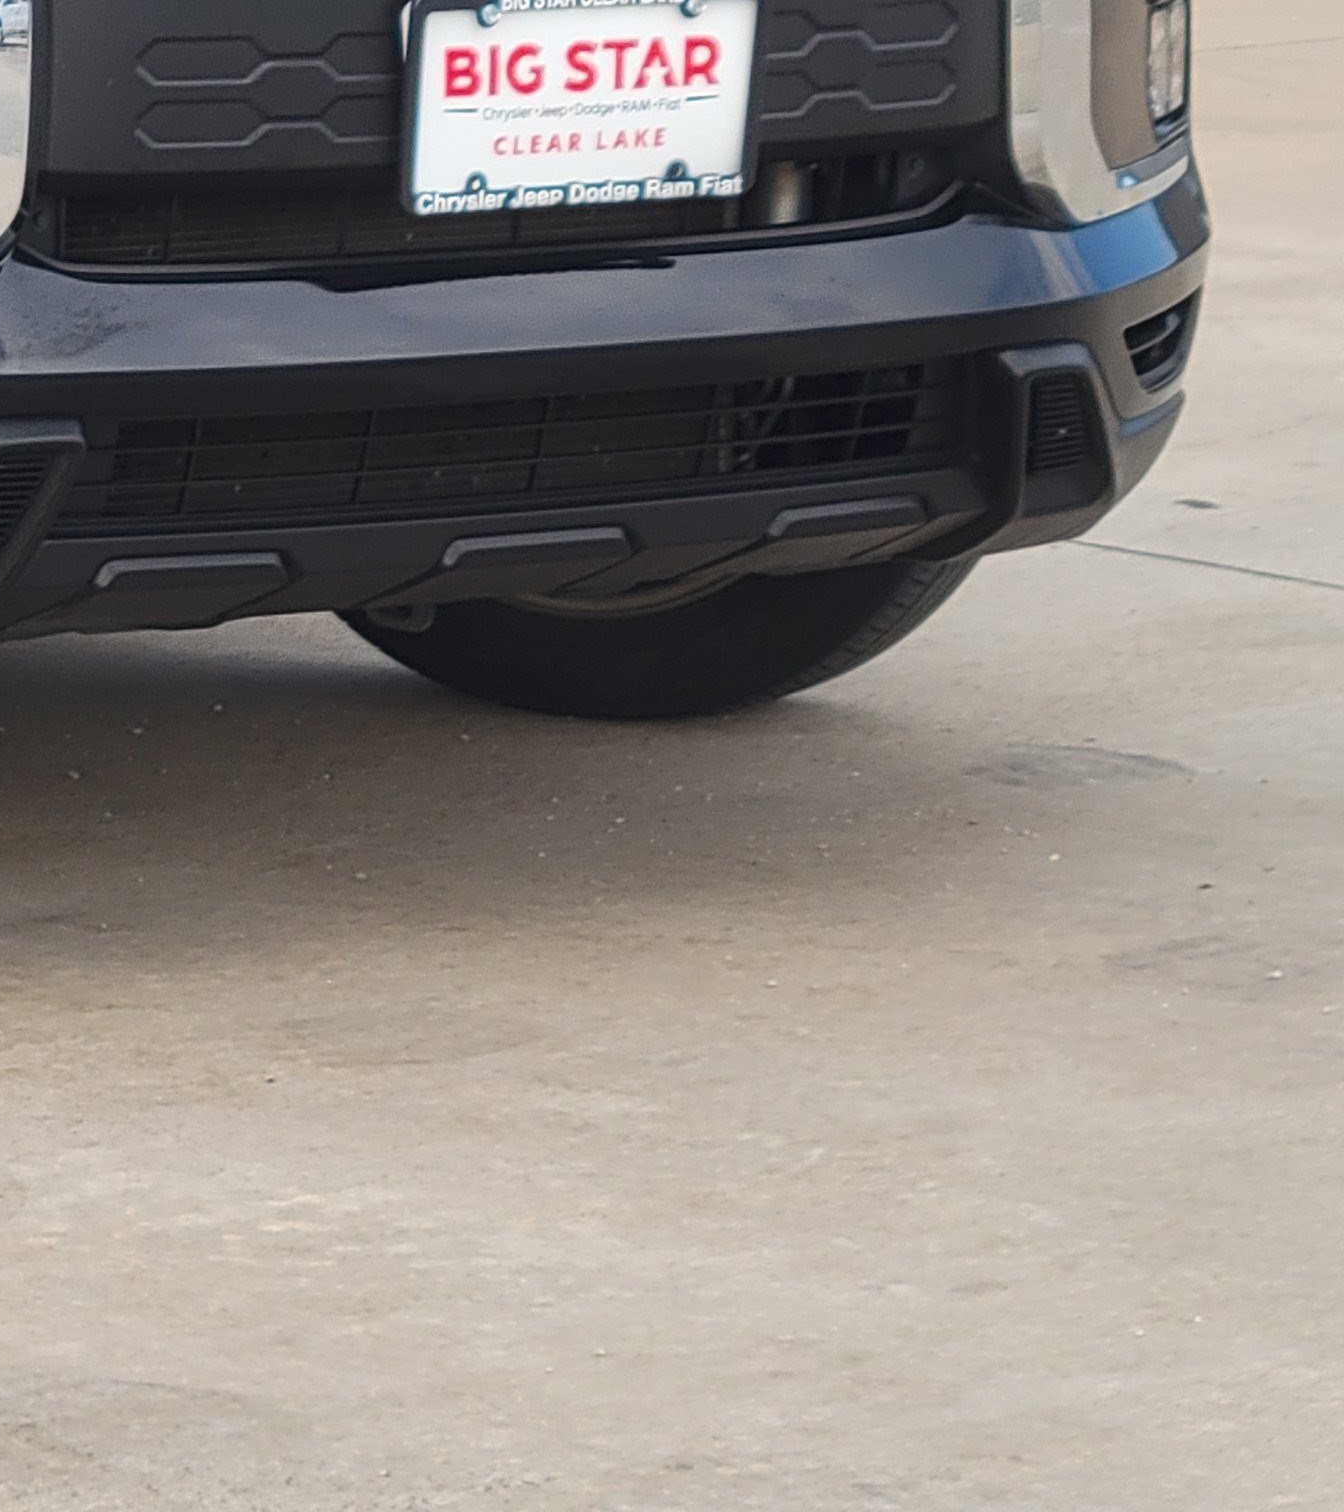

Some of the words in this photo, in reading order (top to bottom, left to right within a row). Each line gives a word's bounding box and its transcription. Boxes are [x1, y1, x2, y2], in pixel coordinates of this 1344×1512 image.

[443, 44, 546, 98] BIG
[563, 35, 719, 93] STAR
[493, 135, 582, 155] CLEAR
[596, 127, 668, 150] LAKE
[416, 190, 505, 214] Chrysler
[507, 186, 563, 208] Jeep
[567, 180, 640, 204] Dodge
[645, 176, 696, 198] Ram
[699, 173, 743, 195] Fiat
